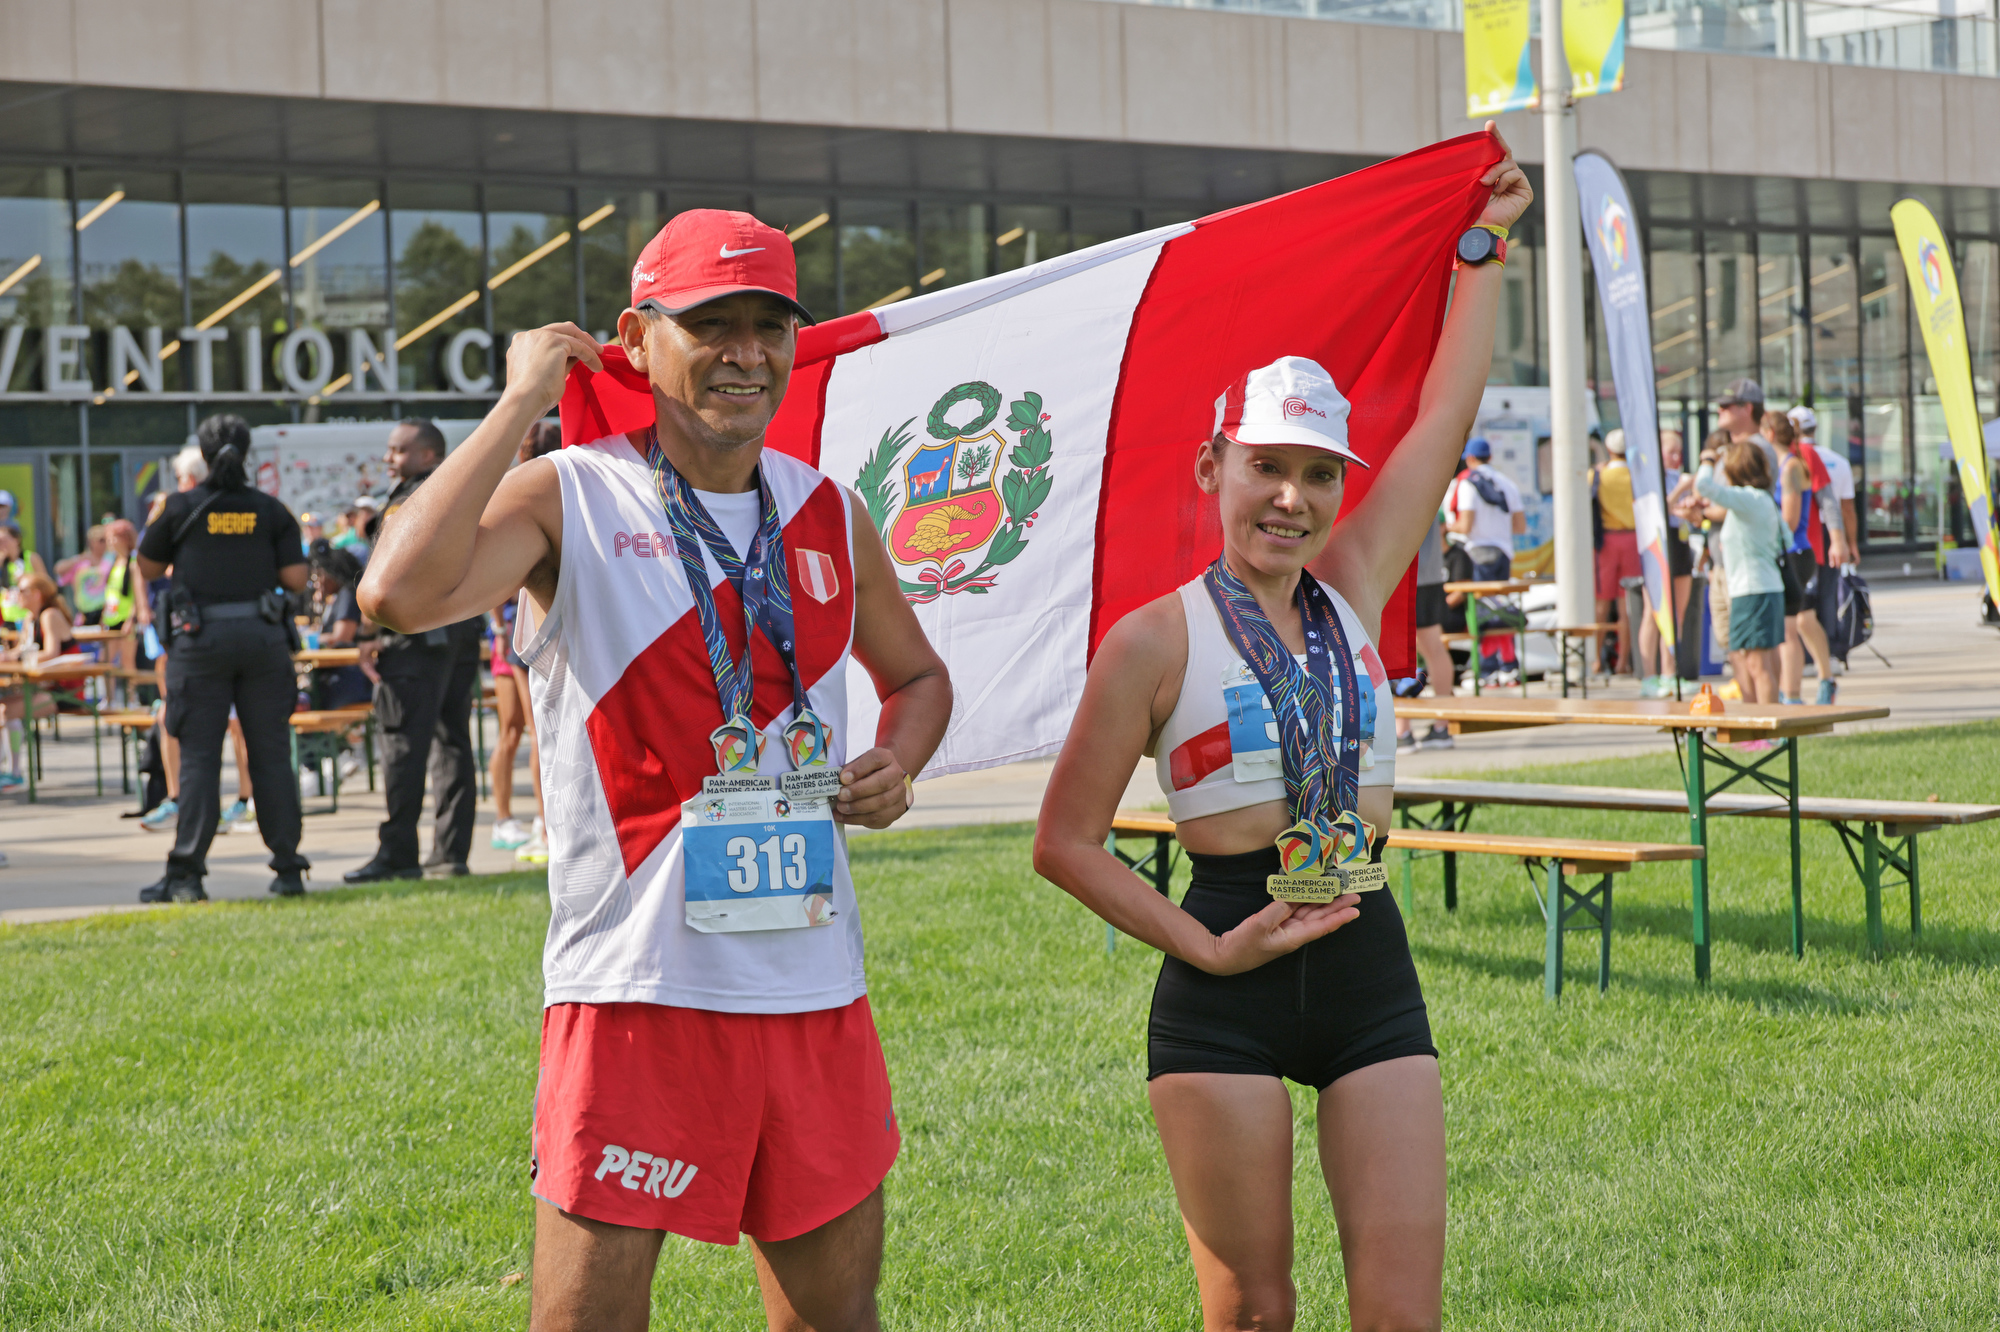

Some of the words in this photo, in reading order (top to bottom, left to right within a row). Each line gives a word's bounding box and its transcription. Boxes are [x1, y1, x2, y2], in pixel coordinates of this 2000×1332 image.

[207, 511, 257, 535] SHERIFF
[1321, 604, 1336, 628] ATHLETES
[1248, 649, 1269, 675] ATHLETES
[786, 770, 839, 782] PAN-AMERICAN
[709, 779, 770, 787] PAN-AMERICAN
[785, 780, 816, 790] MASTERS
[726, 833, 808, 893] 313
[1348, 866, 1383, 877] MERICAN
[1272, 878, 1334, 887] PAN-AMERICAN
[1358, 873, 1386, 883] GAMES
[1270, 886, 1306, 894] MASTERS
[1307, 886, 1337, 895] GAMES
[594, 1144, 699, 1199] PERU
